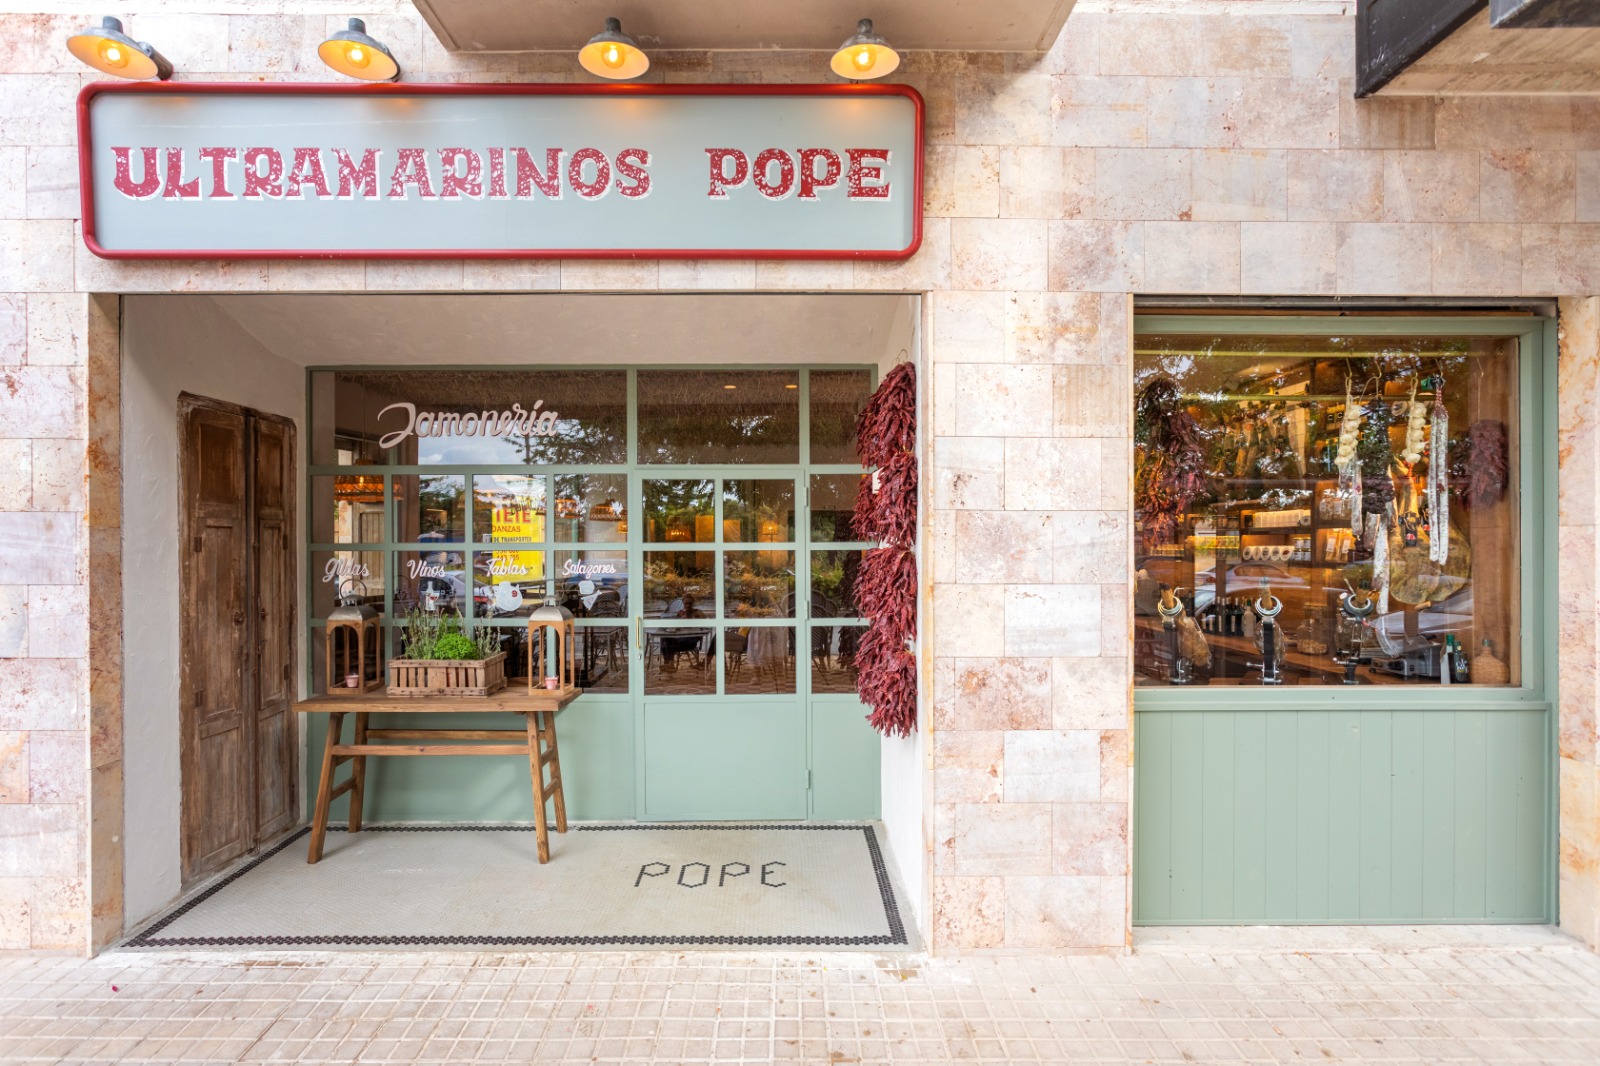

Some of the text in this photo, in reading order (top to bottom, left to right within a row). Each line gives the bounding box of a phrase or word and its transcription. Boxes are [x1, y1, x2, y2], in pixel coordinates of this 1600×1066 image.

[113, 147, 893, 203] ULTRAMARINOS POPE
[377, 399, 559, 450] Jamonería
[407, 559, 446, 579] Vinos
[486, 558, 527, 577] Tablas
[562, 559, 616, 580] Salazones
[634, 861, 787, 888] POPE
